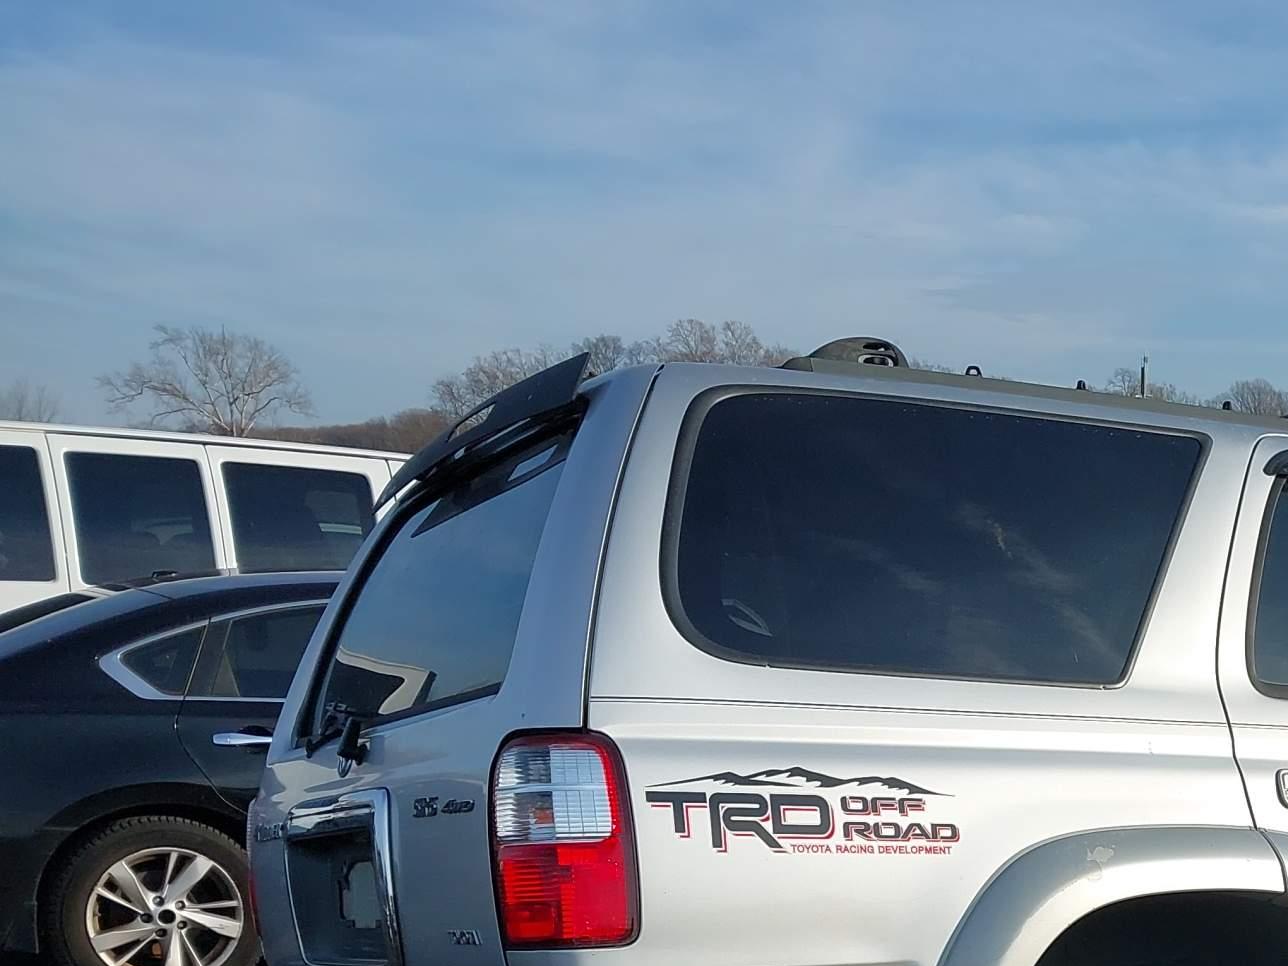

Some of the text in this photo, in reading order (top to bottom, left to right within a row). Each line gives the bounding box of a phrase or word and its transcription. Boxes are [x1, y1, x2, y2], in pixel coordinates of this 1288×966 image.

[840, 796, 926, 816] OFF
[645, 791, 836, 852] TRD
[842, 821, 960, 841] ROAD
[791, 844, 953, 855] TOYOTA RACING DEVELOPMENT
